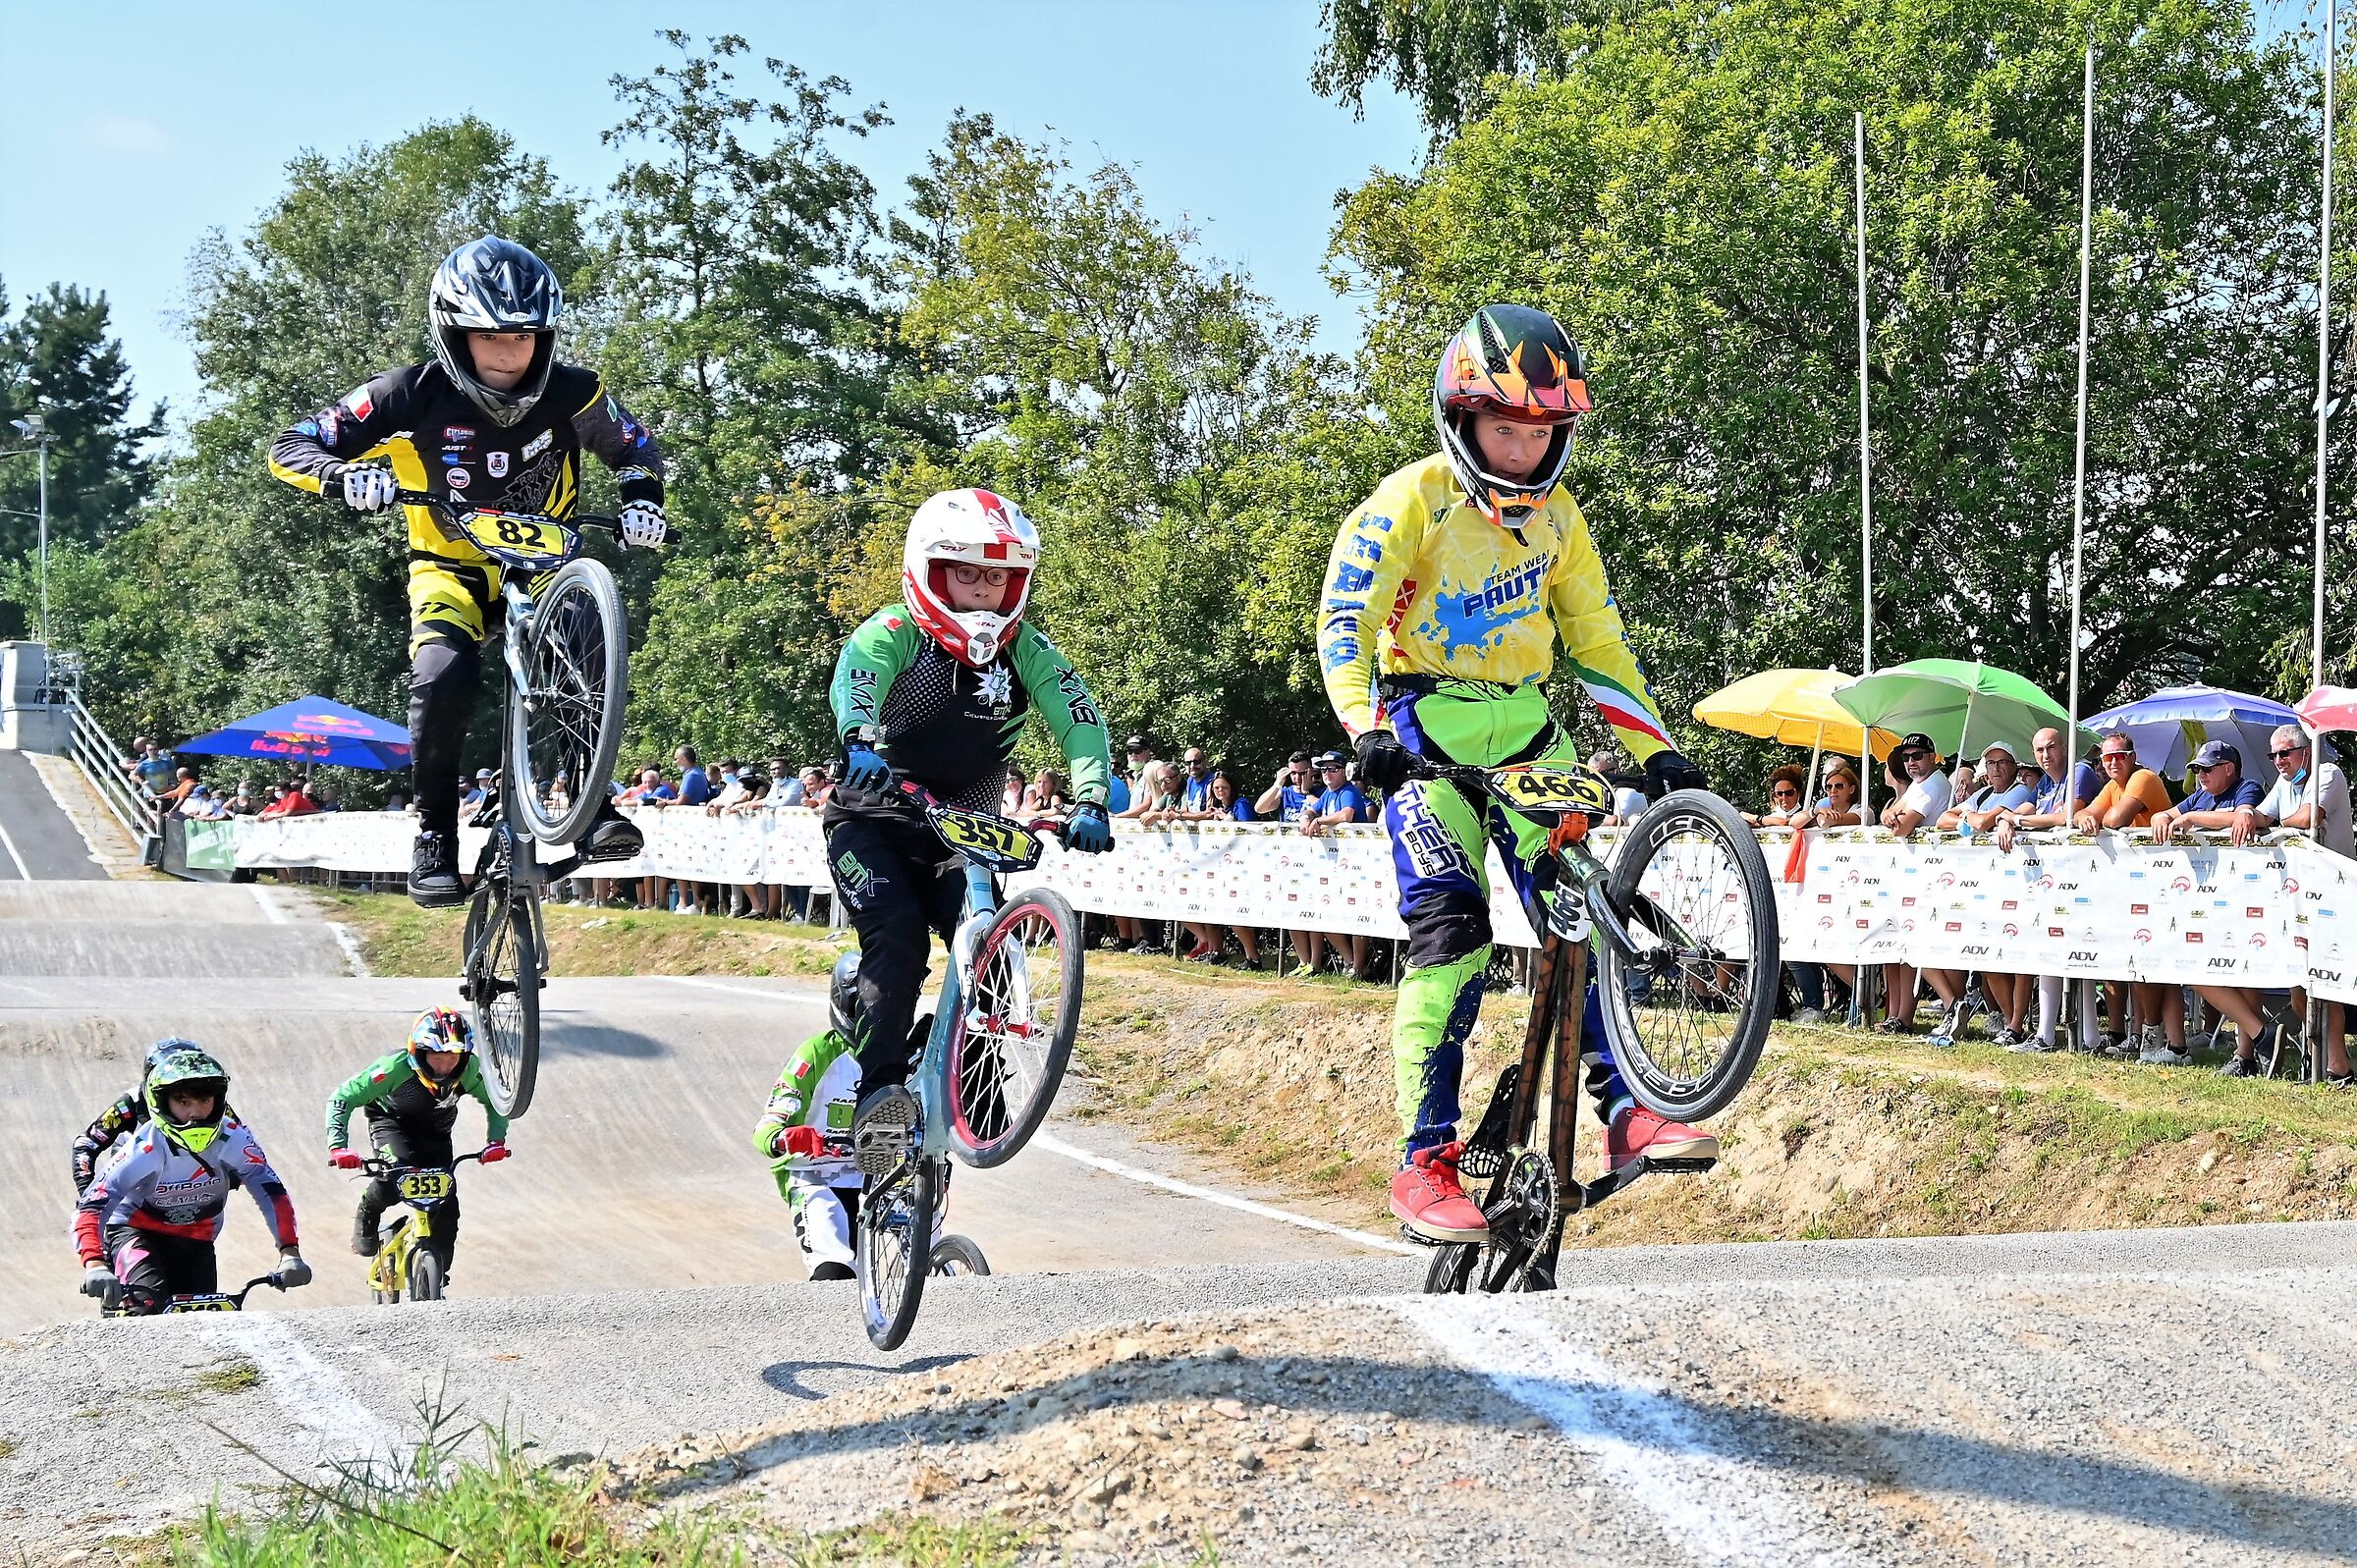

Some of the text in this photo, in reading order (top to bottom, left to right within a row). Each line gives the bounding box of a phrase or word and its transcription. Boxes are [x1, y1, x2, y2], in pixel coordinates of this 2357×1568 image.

[495, 519, 546, 549] 82
[1490, 565, 1521, 585] TEAM
[849, 668, 879, 725] BMX
[1053, 664, 1100, 729] BMX
[1517, 775, 1599, 803] 466
[954, 816, 1014, 853] 357
[1399, 781, 1457, 873] THER
[1405, 831, 1437, 877] BOYS
[2023, 858, 2041, 867] ADV
[837, 850, 890, 897] BMX
[2266, 861, 2287, 870] ADV
[2197, 885, 2218, 893] ADV
[2305, 891, 2323, 900] DV
[1551, 884, 1584, 936] 466
[1960, 945, 1990, 955] ADV
[2067, 950, 2099, 961] ADV
[2207, 957, 2236, 968] ADV
[2308, 967, 2342, 982] ADV
[410, 1175, 441, 1196] 353
